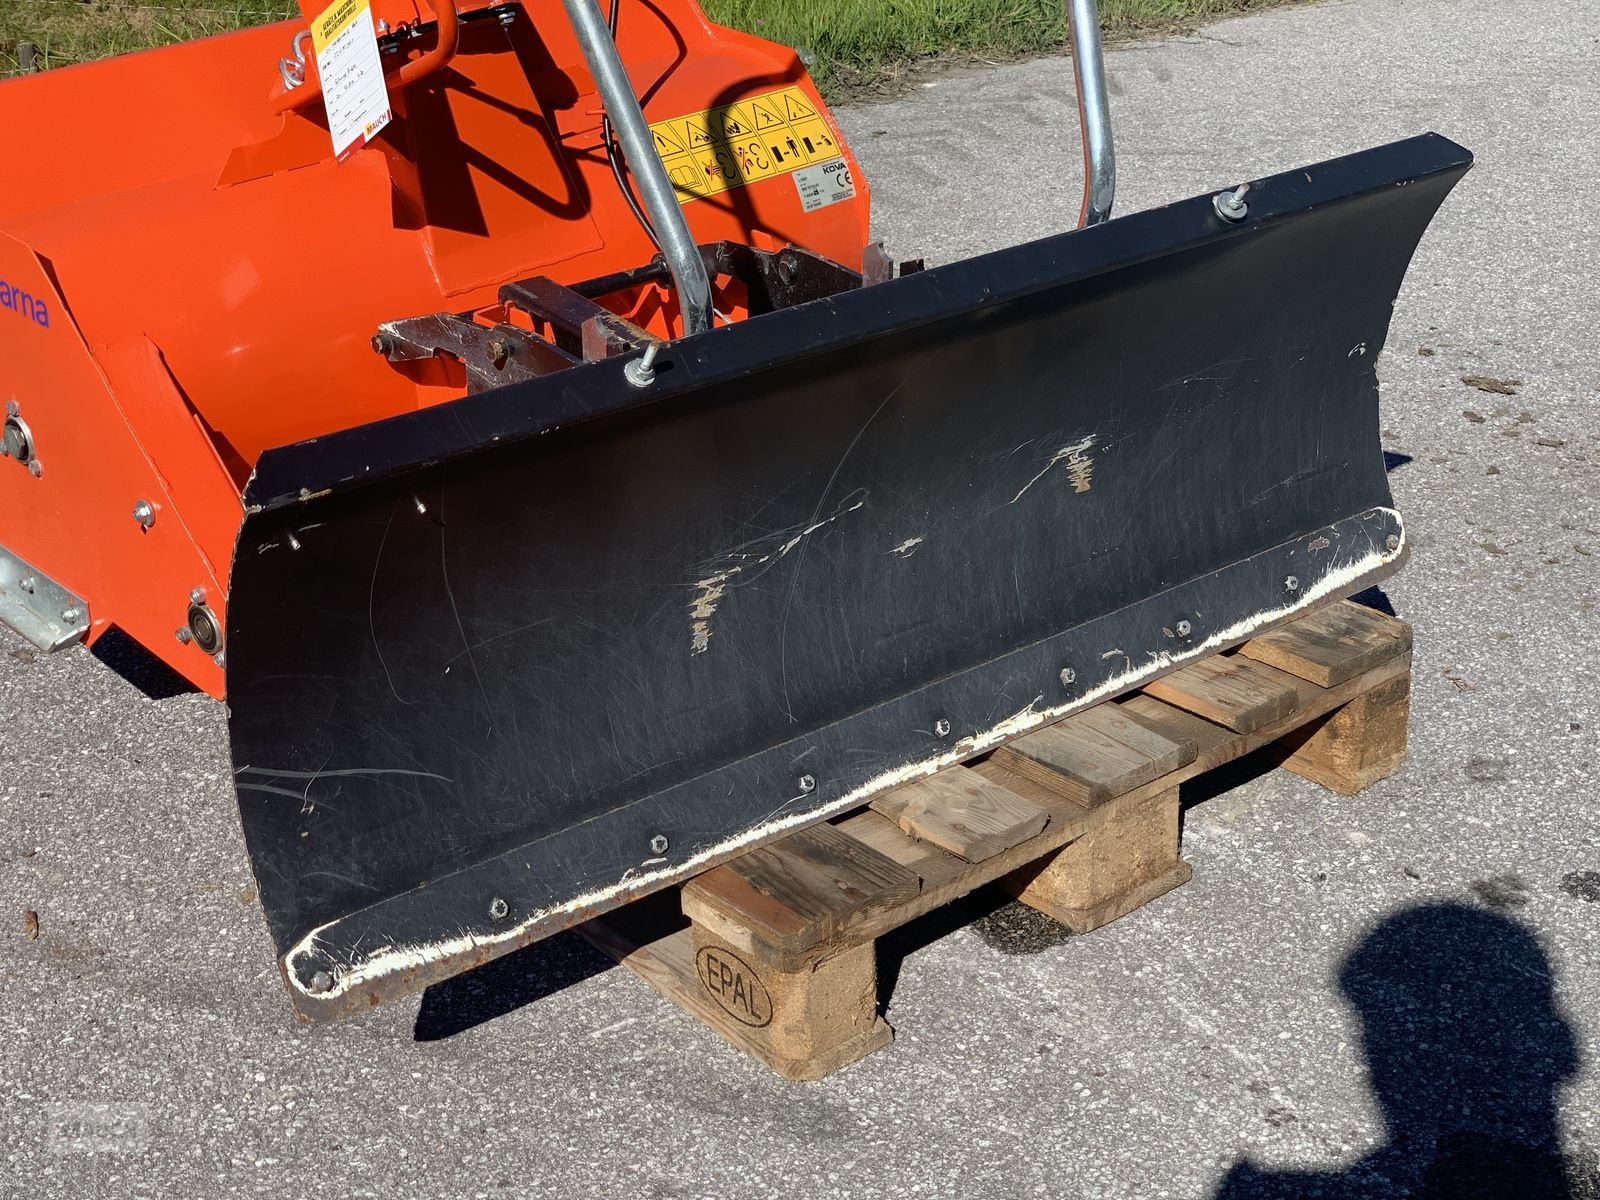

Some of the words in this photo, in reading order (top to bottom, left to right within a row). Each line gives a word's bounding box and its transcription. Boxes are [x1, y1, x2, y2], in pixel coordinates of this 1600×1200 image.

[366, 112, 387, 136] MAUCH
[822, 162, 847, 175] KOVA
[0, 280, 49, 328] arna
[706, 953, 761, 1020] EPAL
